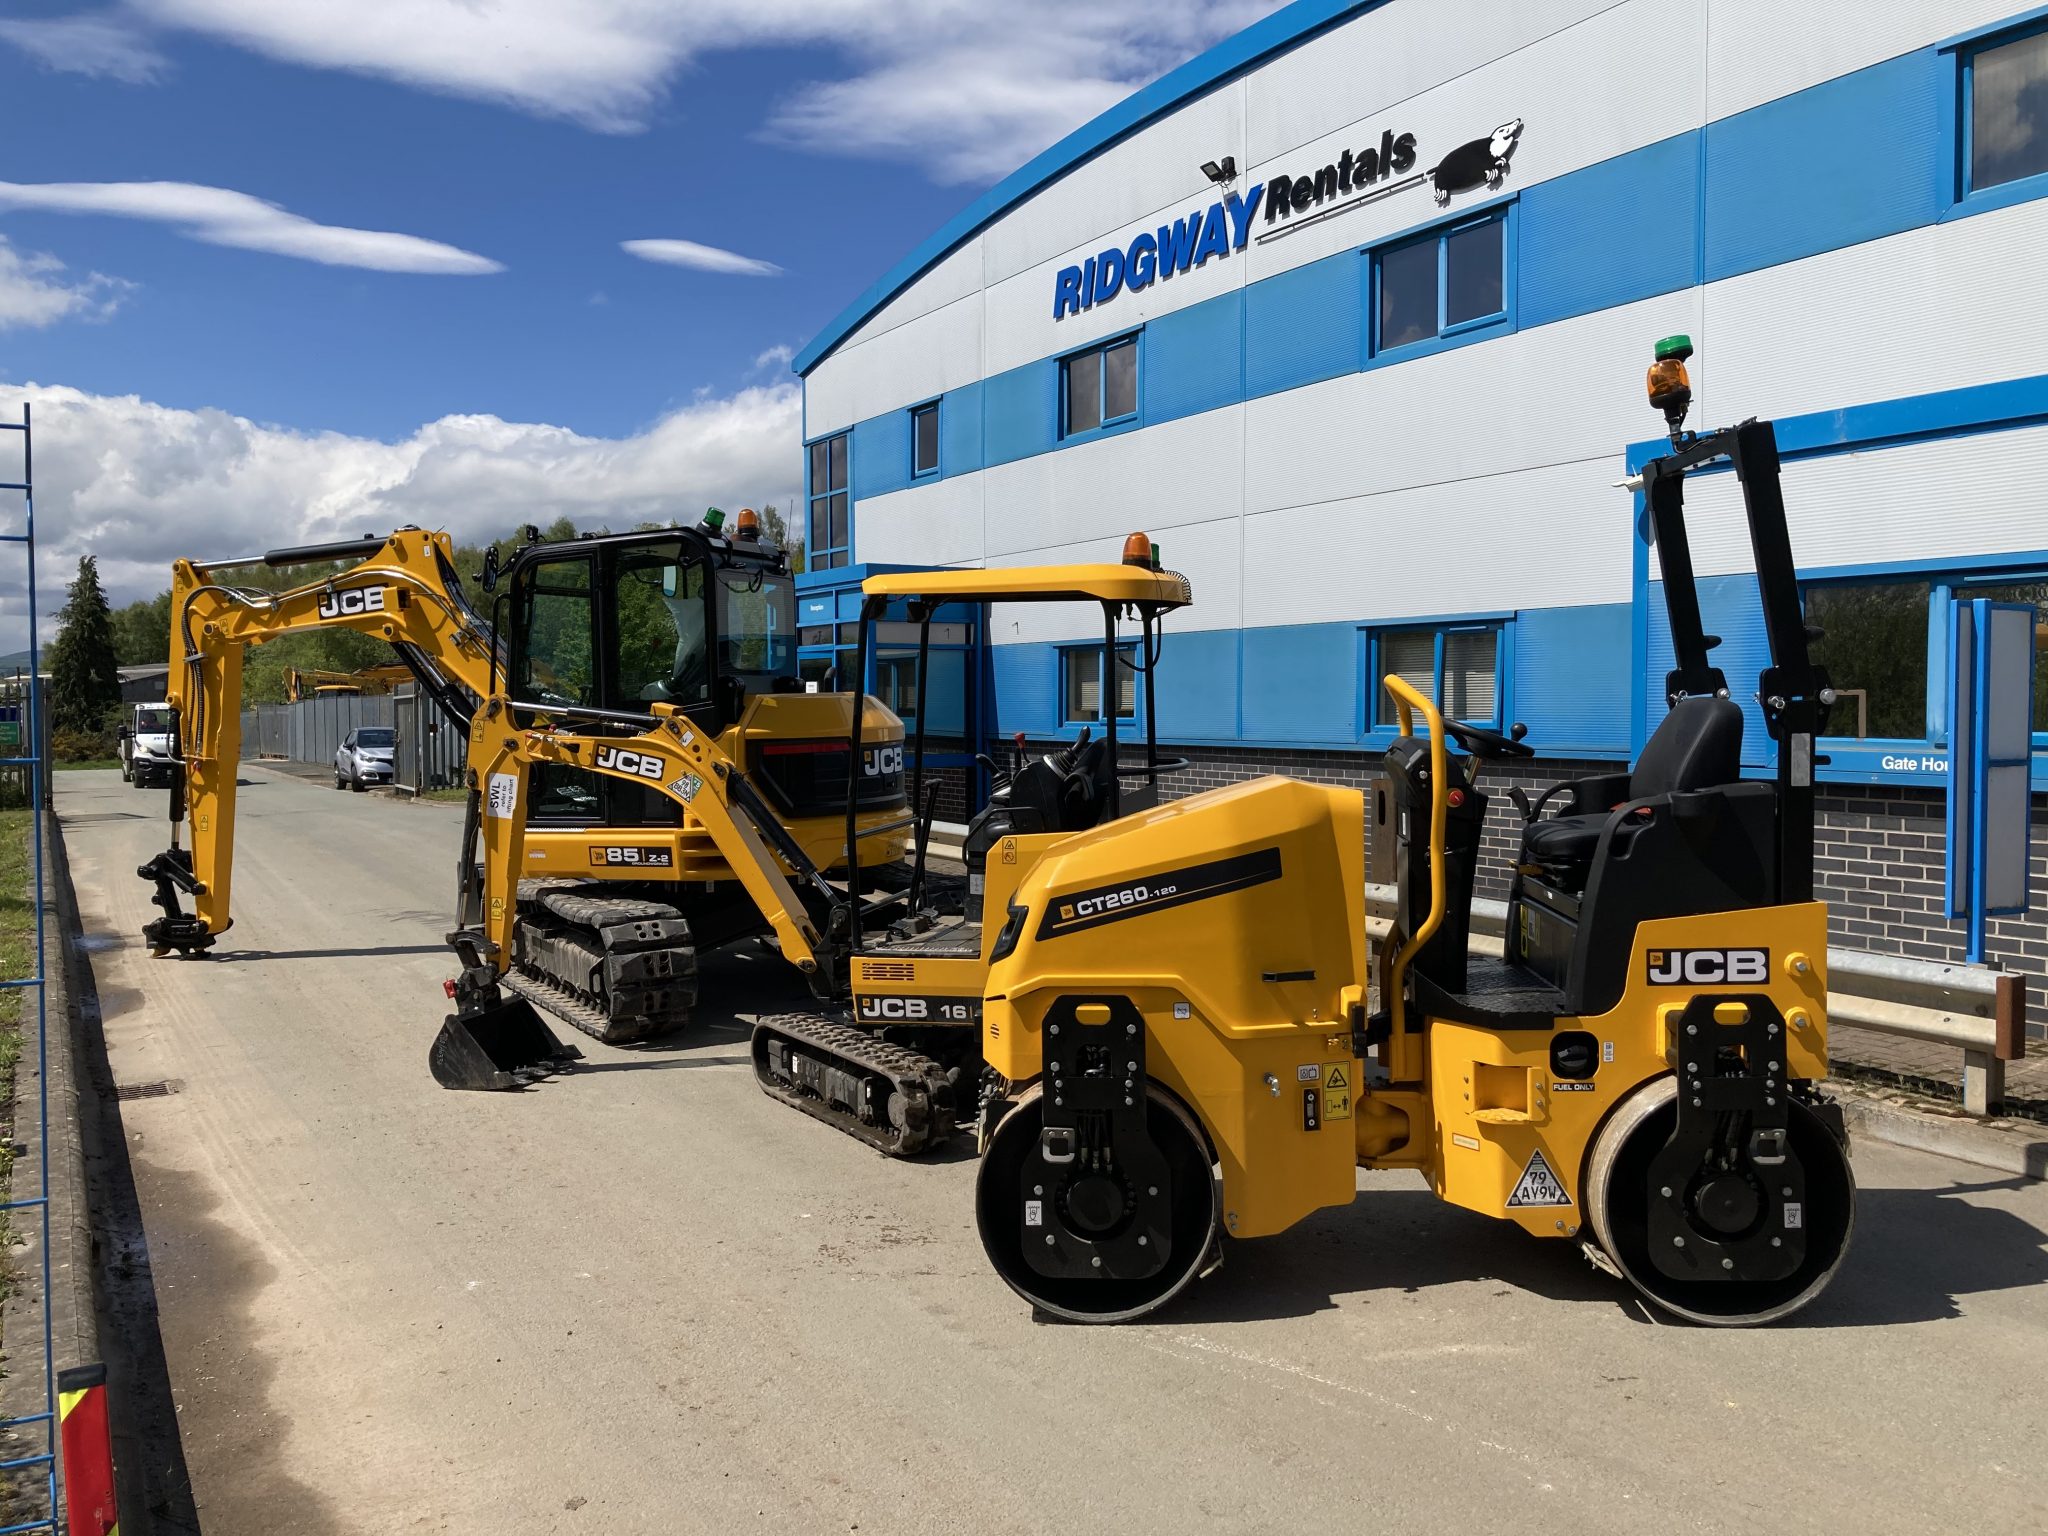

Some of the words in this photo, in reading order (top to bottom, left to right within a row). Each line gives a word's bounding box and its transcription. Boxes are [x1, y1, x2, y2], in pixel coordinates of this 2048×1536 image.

[1053, 183, 1264, 319] RIDGWAY
[1264, 129, 1417, 221] Rentals
[597, 748, 663, 779] JCB
[864, 747, 903, 776] JCB
[1882, 756, 1918, 771] Gate
[490, 781, 501, 809] SWL
[606, 848, 639, 862] 85
[1649, 950, 1767, 982] JCB
[862, 998, 928, 1018] JCB
[940, 1004, 967, 1019] 16
[1553, 1083, 1572, 1091] FUEL
[1574, 1083, 1594, 1091] ONLY
[1529, 1171, 1547, 1186] 79
[1521, 1185, 1557, 1200] AY9W
